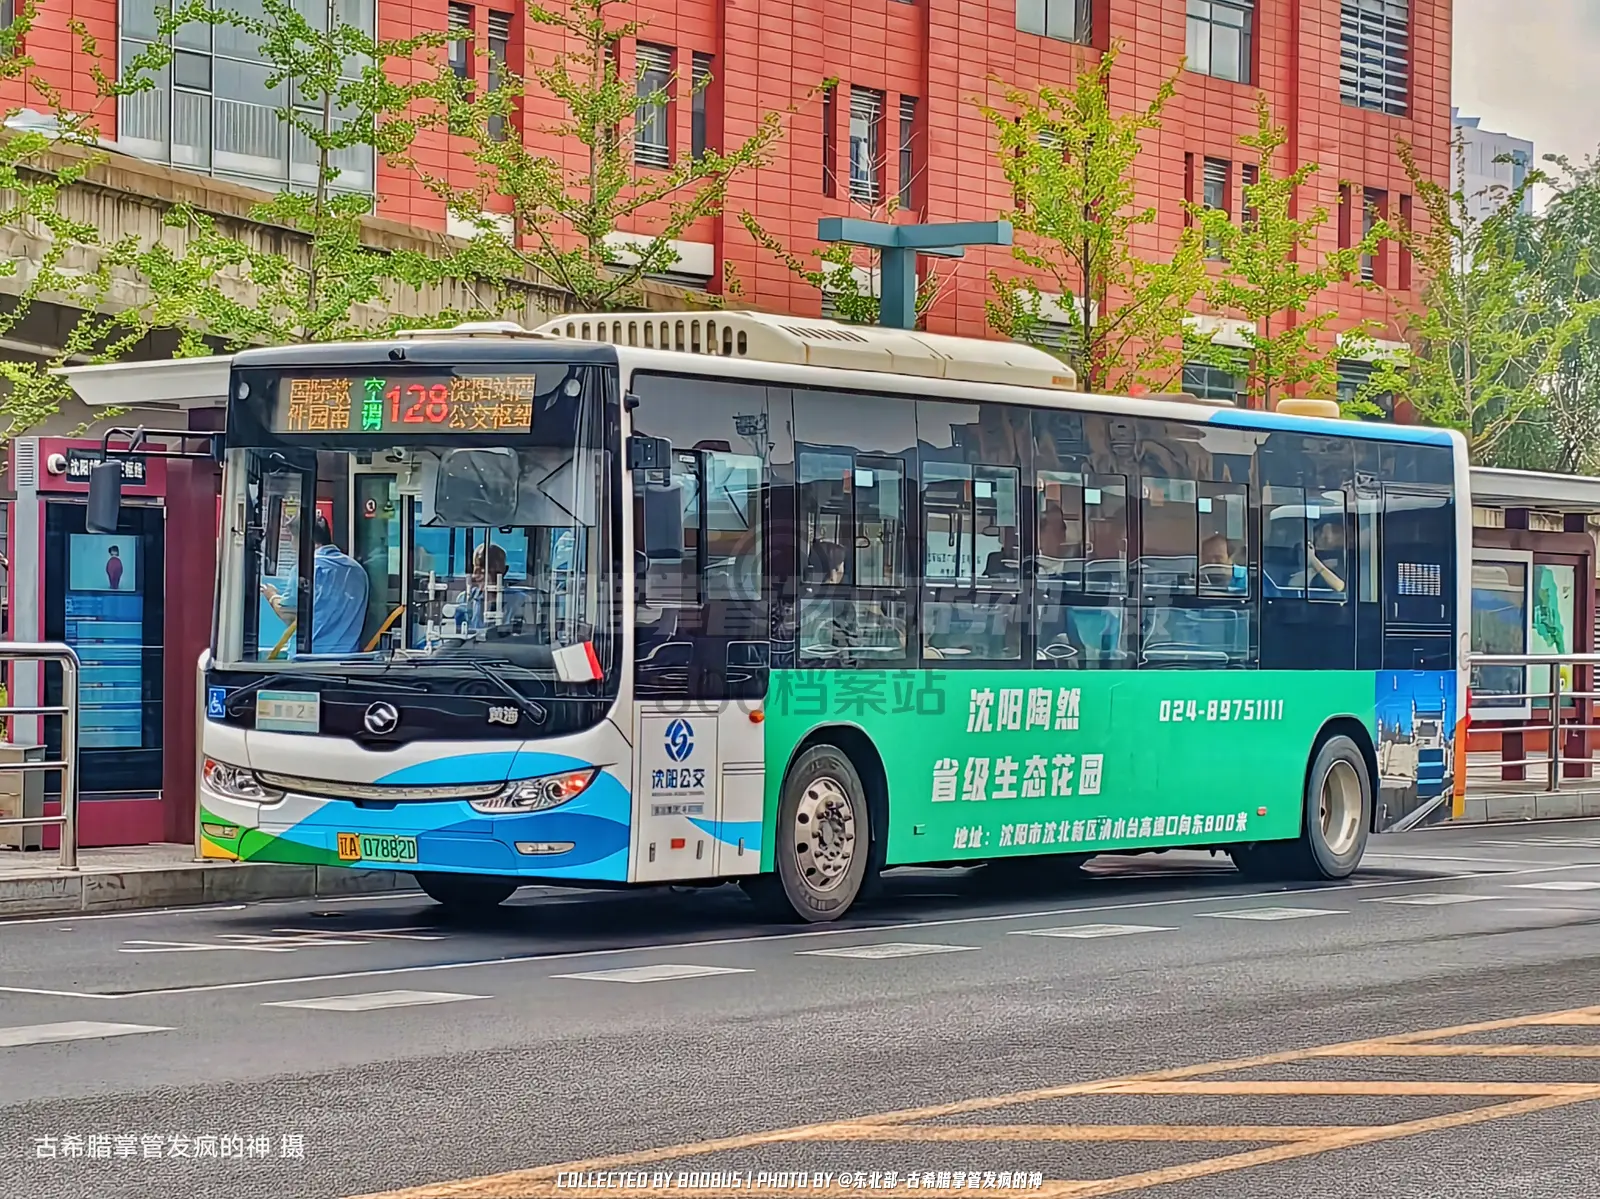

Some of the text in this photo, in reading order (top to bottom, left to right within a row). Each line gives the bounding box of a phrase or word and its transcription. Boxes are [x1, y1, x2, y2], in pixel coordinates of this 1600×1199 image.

[386, 383, 449, 424] 128
[966, 687, 1081, 733] 沈阳陶然
[1159, 699, 1284, 722] 024-89751111
[652, 768, 705, 789] 沈阳公交
[931, 754, 1104, 803] 省级生态花园
